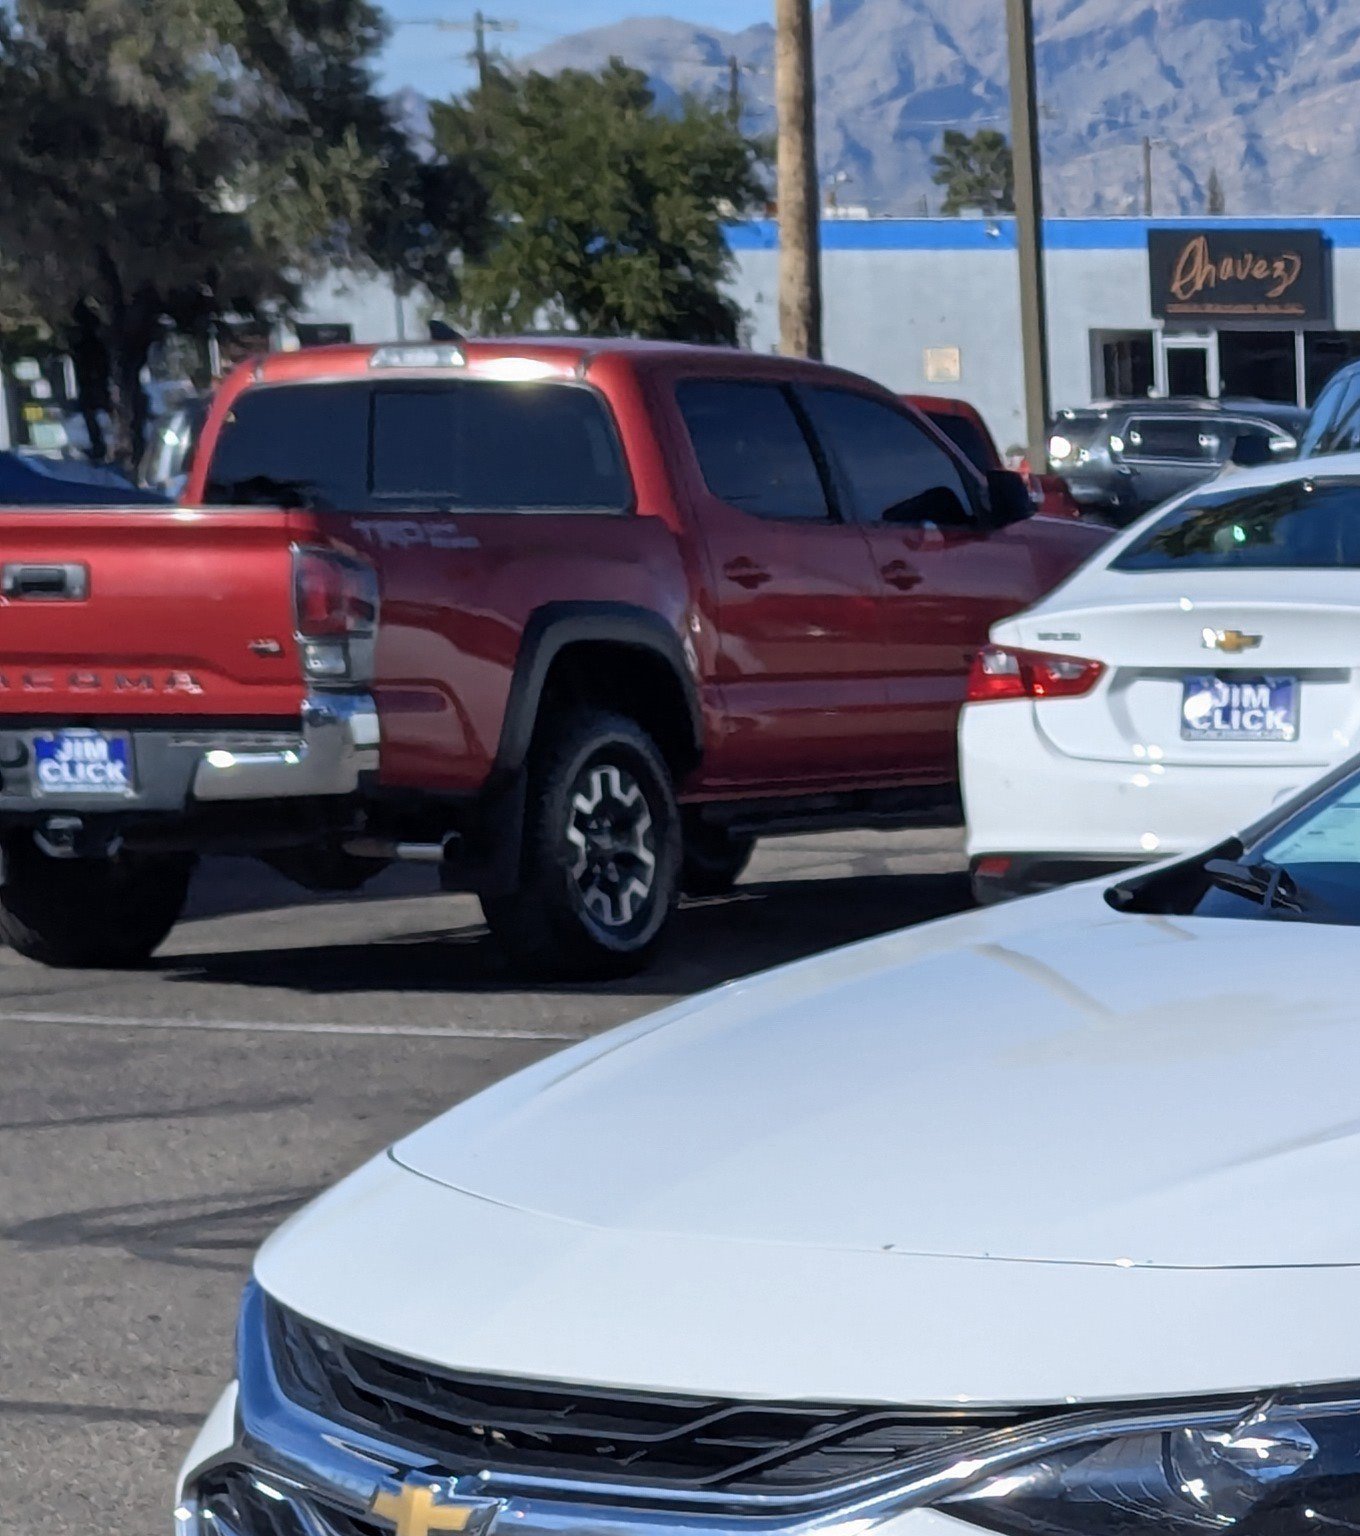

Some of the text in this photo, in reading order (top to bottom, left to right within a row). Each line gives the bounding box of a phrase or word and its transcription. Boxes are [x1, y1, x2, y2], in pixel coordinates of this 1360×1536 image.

[1169, 235, 1302, 301] Chavez
[1212, 682, 1271, 709] JIM
[1190, 707, 1286, 730] CLICK
[53, 738, 108, 762] JIM
[38, 760, 127, 783] CLICK
